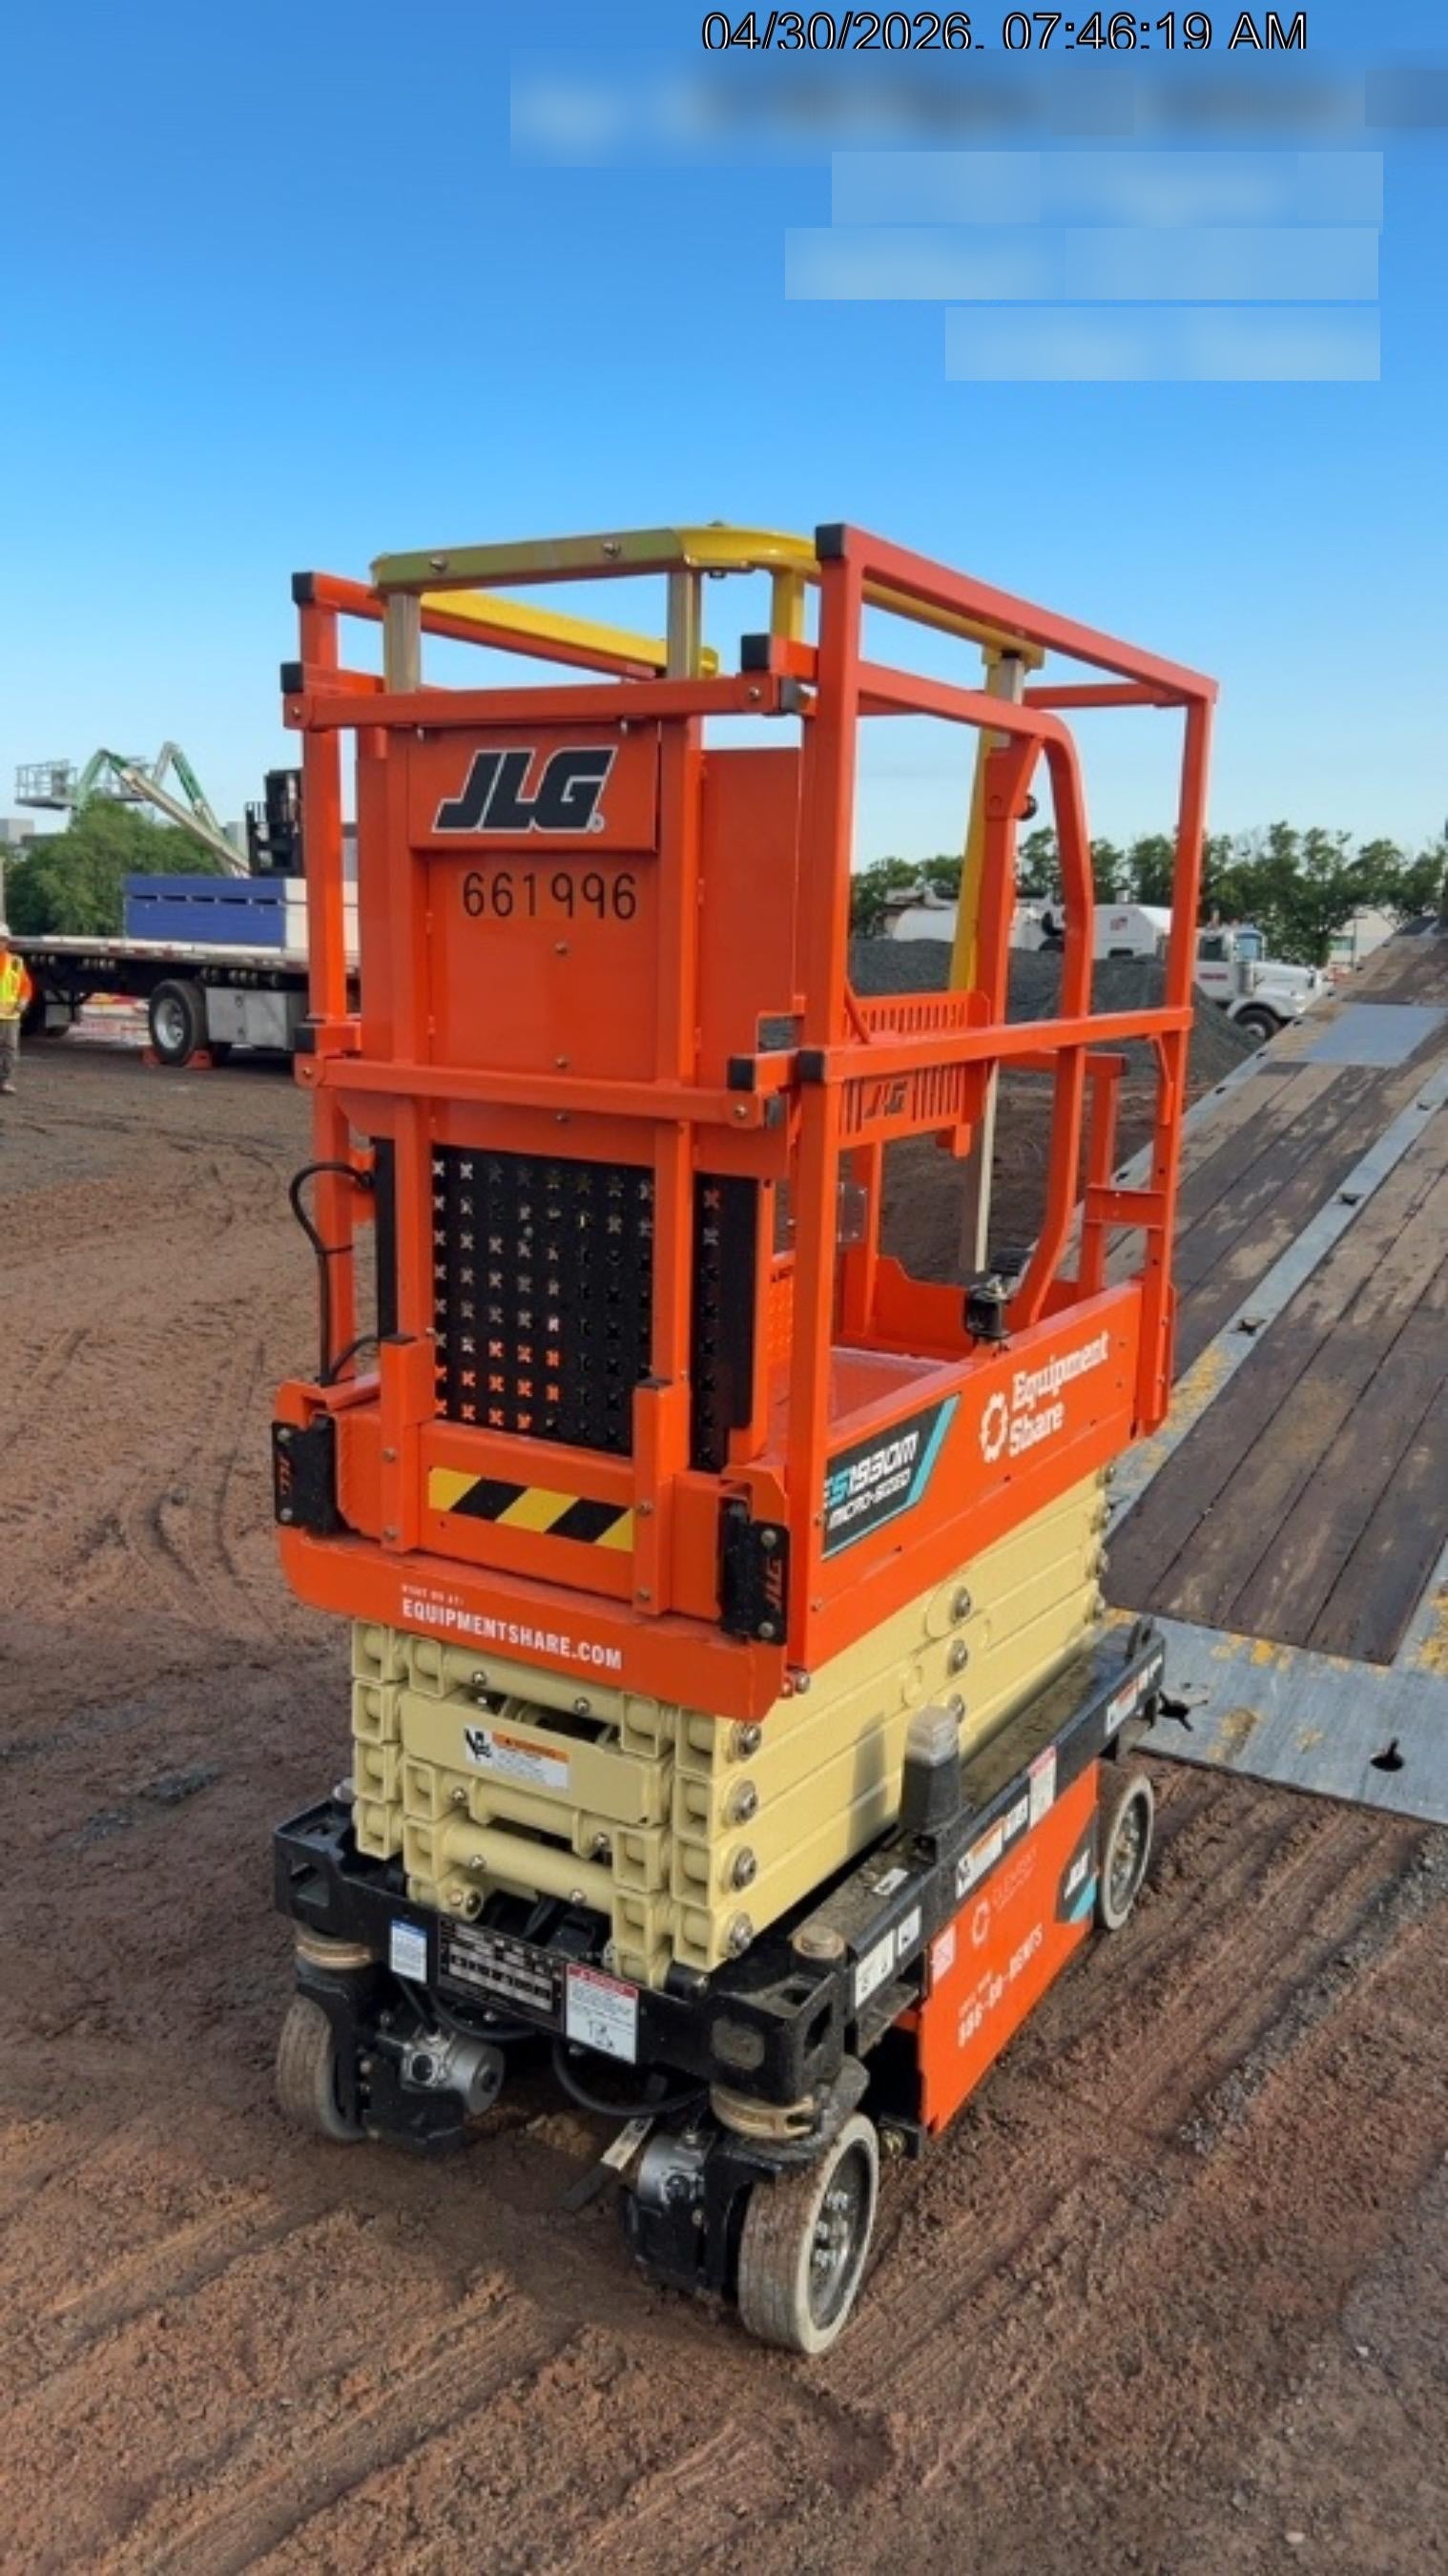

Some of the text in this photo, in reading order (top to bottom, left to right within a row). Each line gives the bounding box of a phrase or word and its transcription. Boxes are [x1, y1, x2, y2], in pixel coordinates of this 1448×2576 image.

[432, 744, 618, 833] JLG
[463, 871, 636, 920] 661996
[1011, 1330, 1110, 1412] Equipment
[1008, 1402, 1065, 1457] Share
[402, 1597, 622, 1670] EQUIPMENTSHARE.COM
